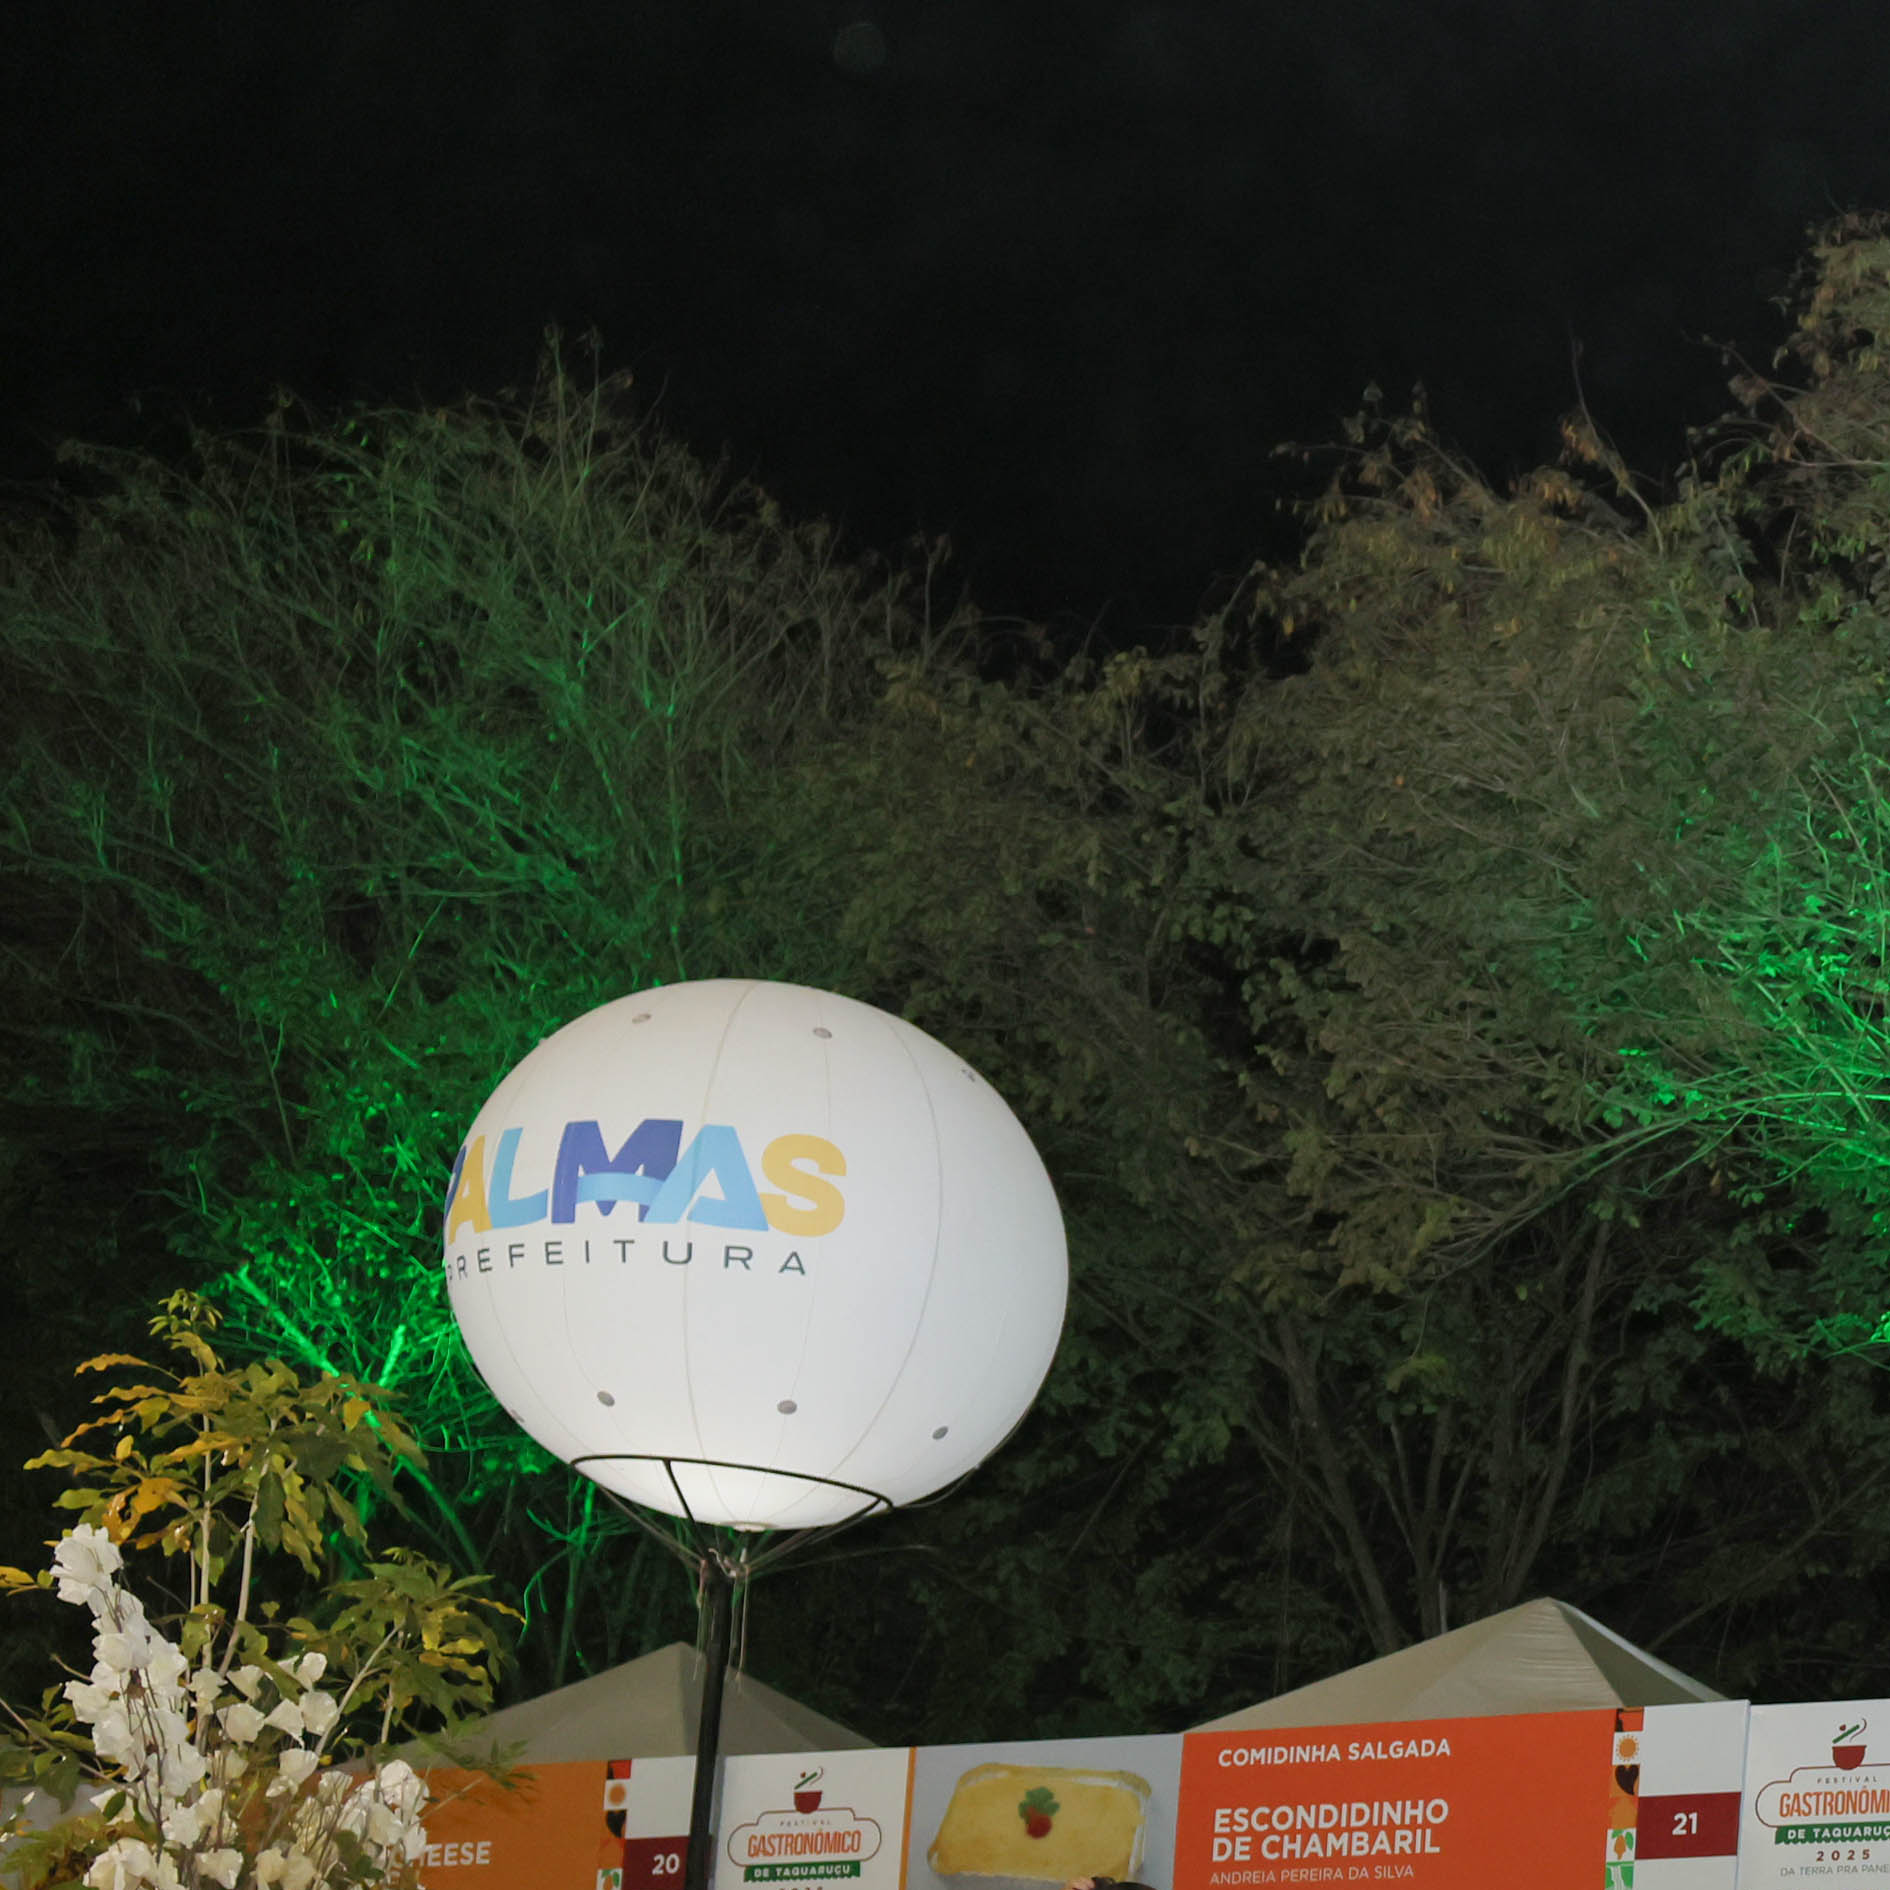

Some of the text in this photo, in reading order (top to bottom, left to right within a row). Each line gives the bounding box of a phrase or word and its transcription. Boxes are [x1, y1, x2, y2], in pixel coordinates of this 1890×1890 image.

[1218, 1738, 1451, 1767] COMIDINHA SALGADA
[1816, 1775, 1879, 1785] FESTIVAL
[1214, 1798, 1449, 1833] ESCONDIDINHO
[1671, 1811, 1699, 1836] 21
[1212, 1828, 1441, 1862] DE CHAMBARIL
[1786, 1829, 1806, 1840] DE
[651, 1853, 680, 1875] 20
[1815, 1848, 1871, 1862] 2025
[753, 1868, 770, 1878] DE
[1210, 1864, 1414, 1885] ANDREIA PEREIRA DA SILVA
[1780, 1867, 1796, 1877] DA
[1799, 1865, 1833, 1876] TERRA
[1836, 1864, 1859, 1875] PRA
